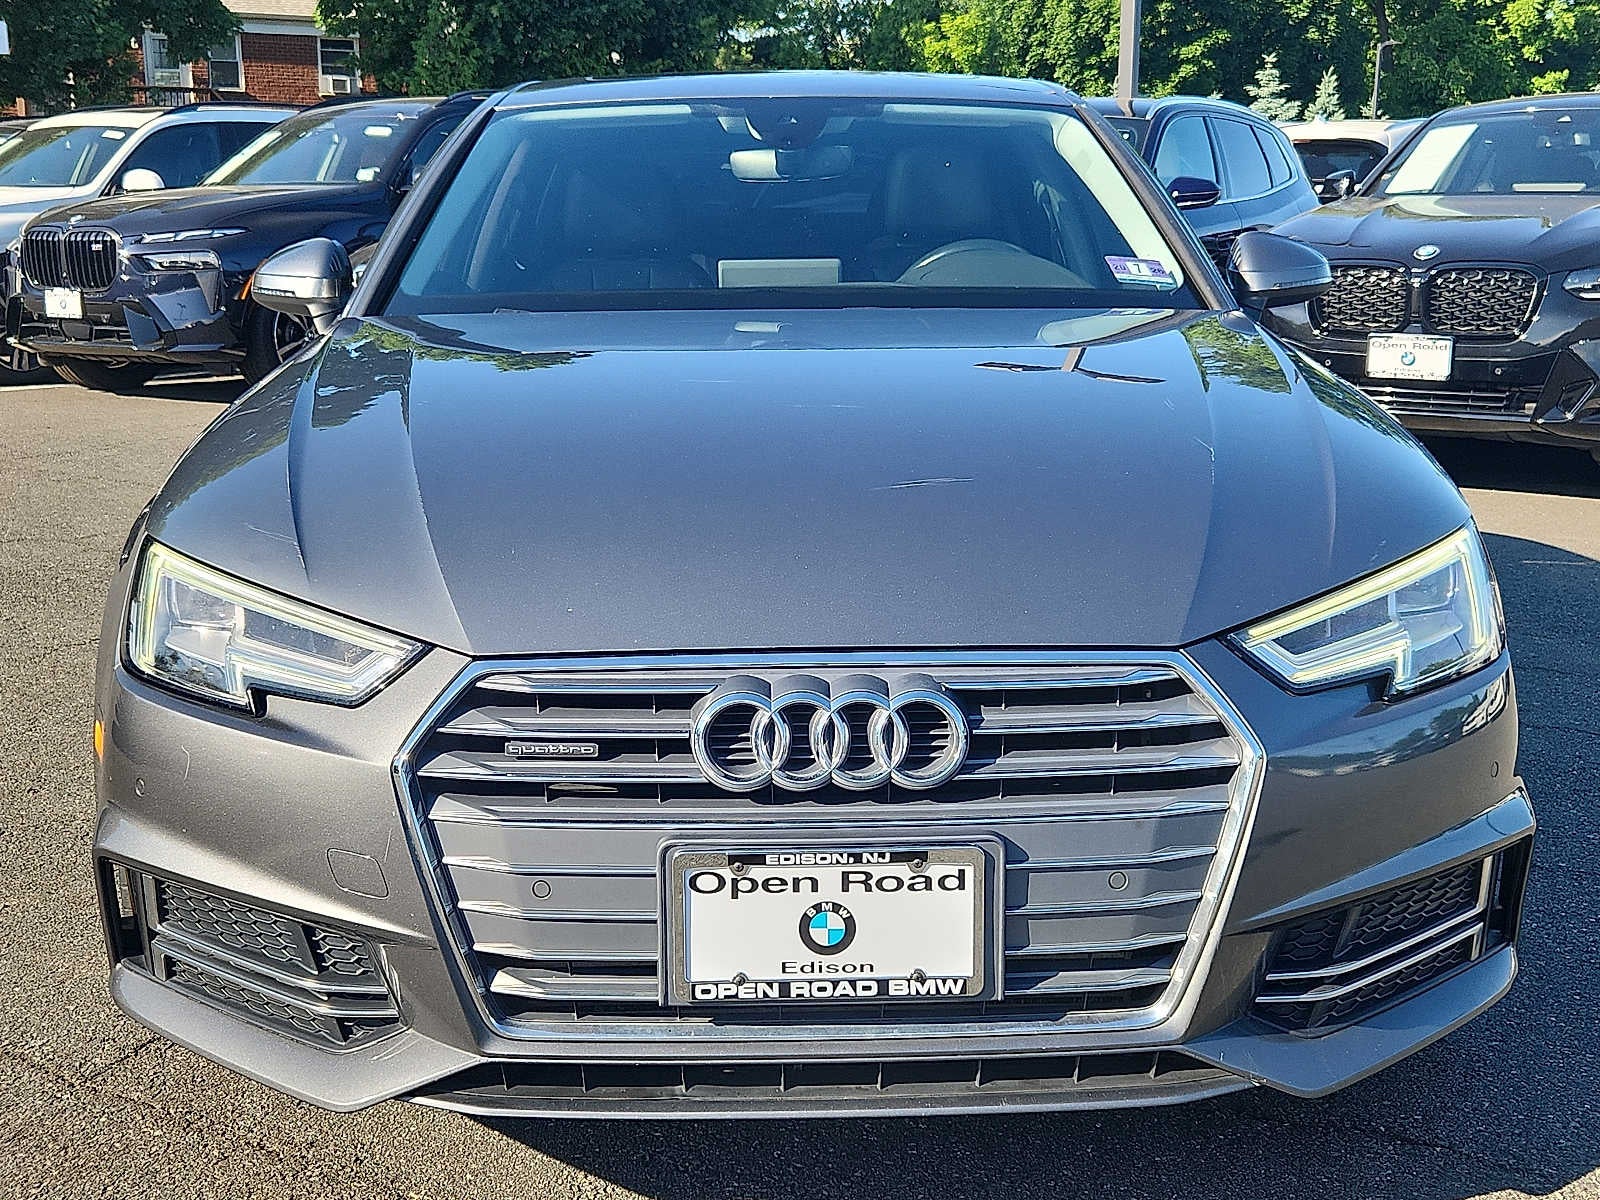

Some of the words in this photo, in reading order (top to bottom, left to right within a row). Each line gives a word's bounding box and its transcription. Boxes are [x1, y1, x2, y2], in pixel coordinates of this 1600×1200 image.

[1371, 340, 1407, 350] Open
[1412, 342, 1448, 351] Road
[508, 745, 595, 755] quattro
[861, 852, 891, 863] NJ
[688, 871, 819, 899] Open
[841, 869, 966, 893] Road
[805, 902, 851, 918] BMW
[781, 961, 874, 974] Edison
[694, 981, 780, 999] OPEN
[790, 980, 879, 998] ROAD
[888, 978, 966, 996] BMW
